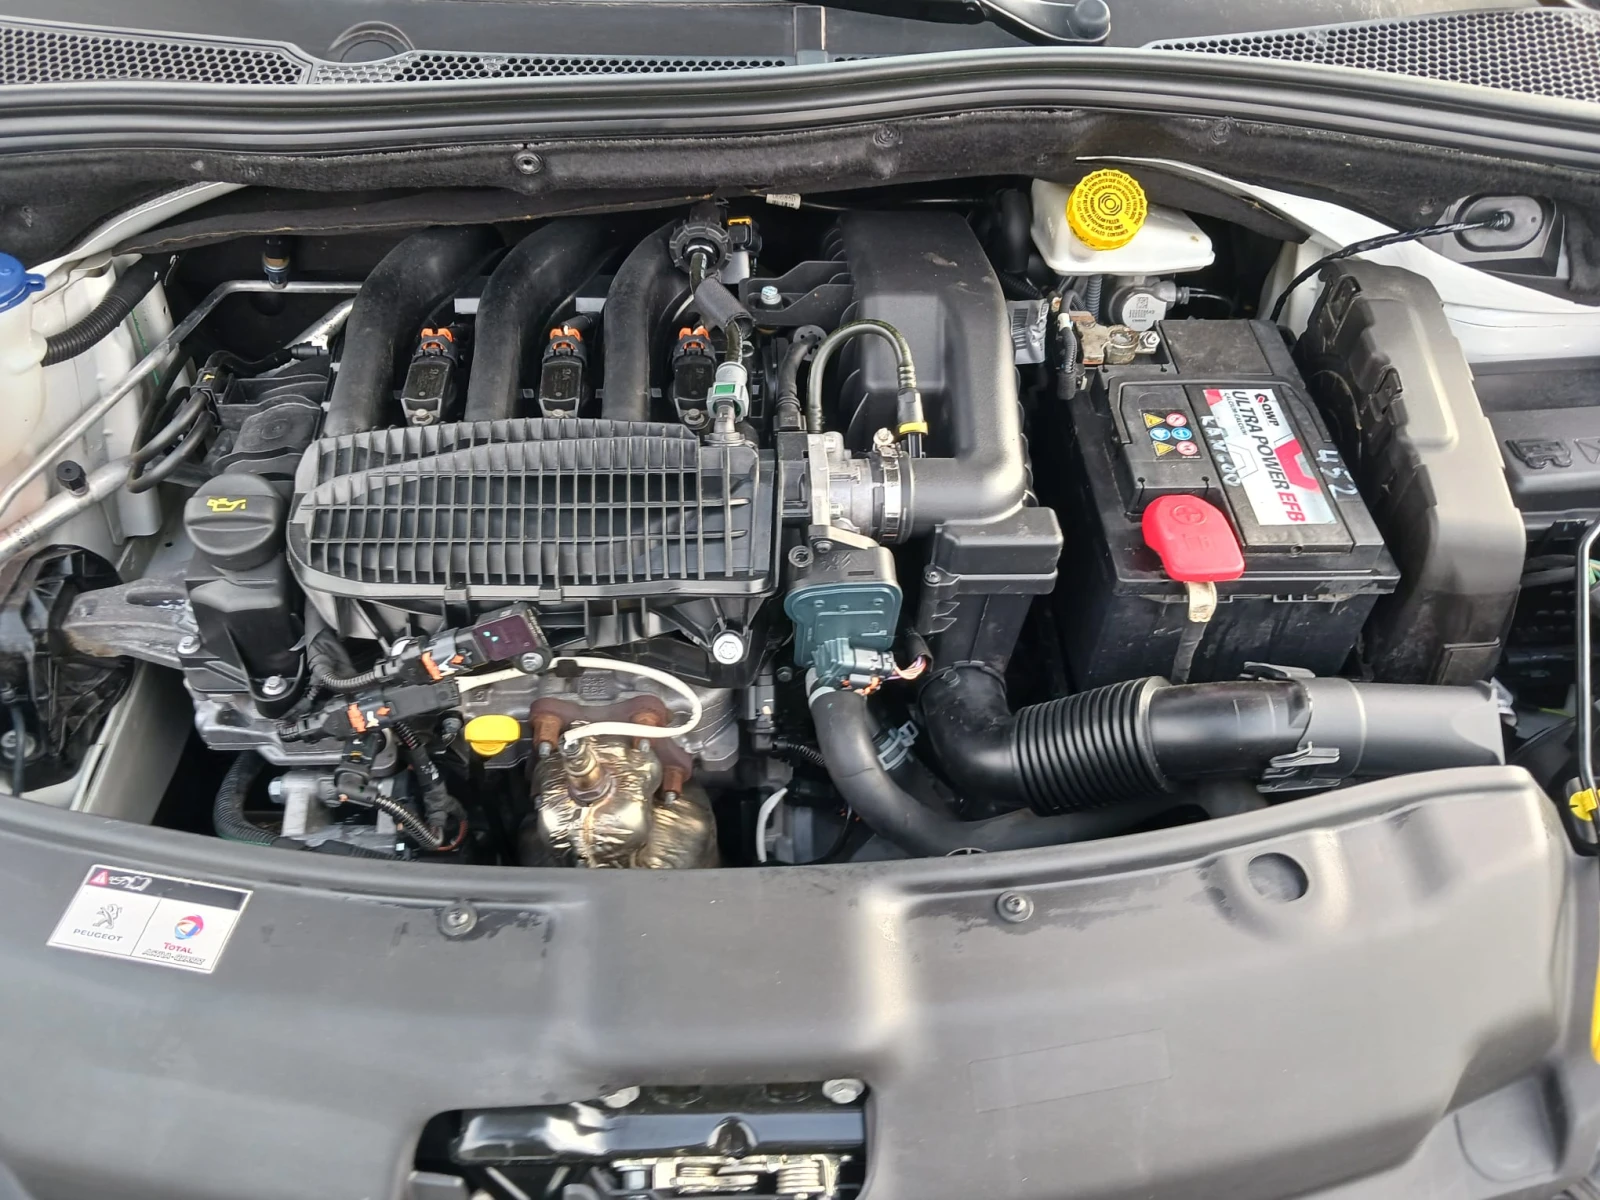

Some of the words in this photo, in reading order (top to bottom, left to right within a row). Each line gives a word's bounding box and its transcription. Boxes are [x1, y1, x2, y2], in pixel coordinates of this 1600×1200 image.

[1083, 173, 1102, 186] ATTENTION
[1232, 391, 1263, 434] ULTRA
[1252, 435, 1290, 490] POWER
[1277, 491, 1306, 522] EFB
[73, 928, 124, 942] PEUGEOT
[164, 942, 193, 954] TOTAL
